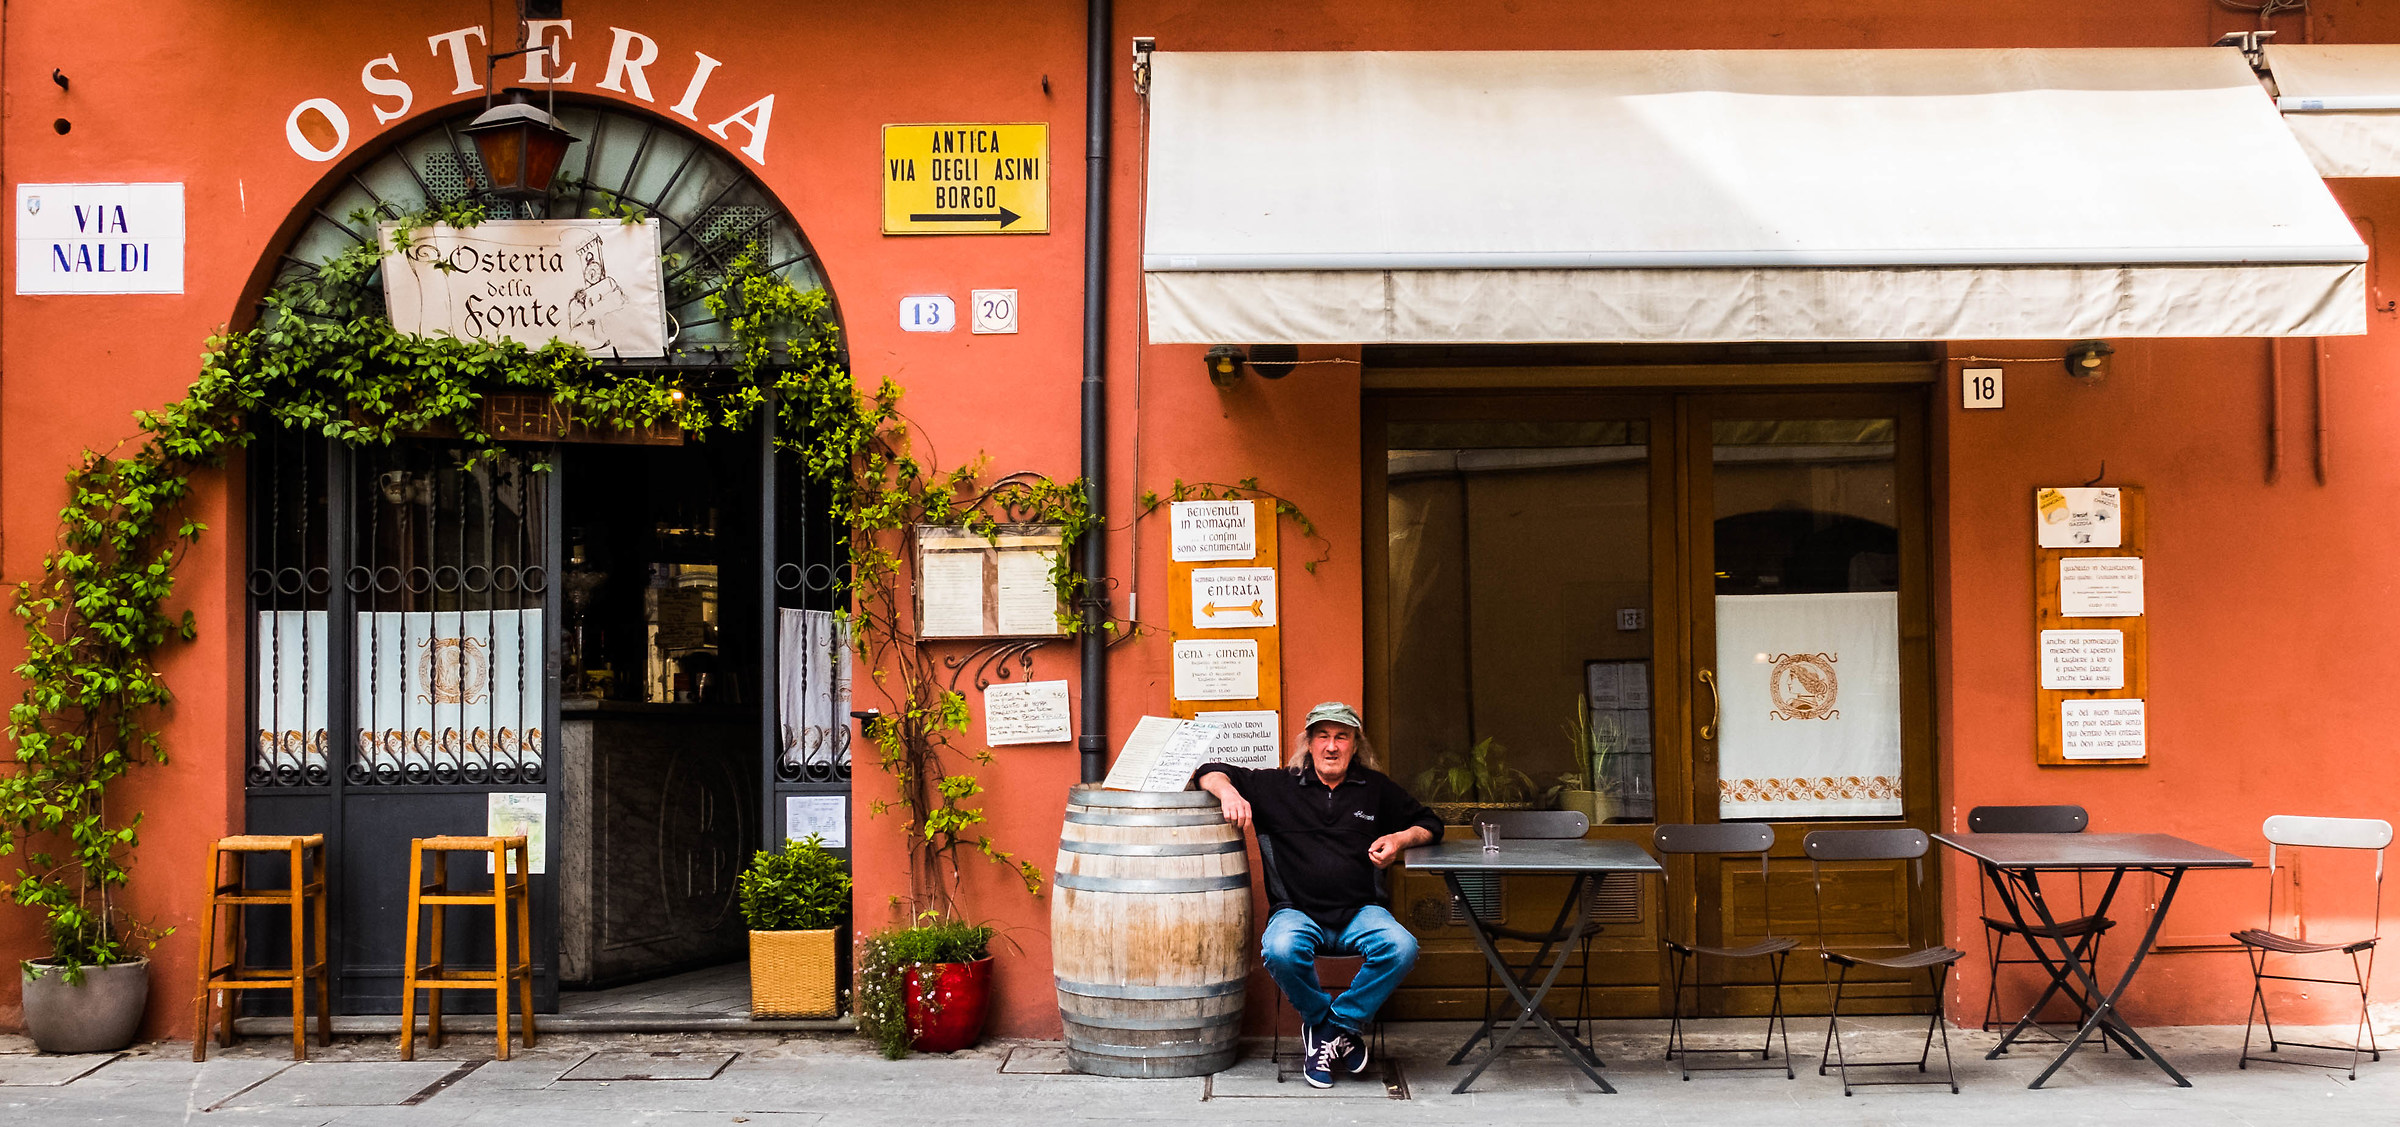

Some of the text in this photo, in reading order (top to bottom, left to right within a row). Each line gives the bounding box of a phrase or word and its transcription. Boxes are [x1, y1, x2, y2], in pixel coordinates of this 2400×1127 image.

[285, 18, 776, 166] OSTERIA
[932, 130, 999, 154] ANTICA
[890, 158, 1039, 182] VIA DEGLI ASINI
[936, 186, 996, 209] BORGO
[73, 203, 128, 234] VIA
[52, 241, 150, 274] NALDI
[449, 244, 565, 274] Osteria
[487, 279, 533, 297] della
[463, 297, 562, 339] Fonte
[912, 302, 940, 325] 13
[983, 299, 1009, 320] 20
[1972, 376, 1995, 400] 18
